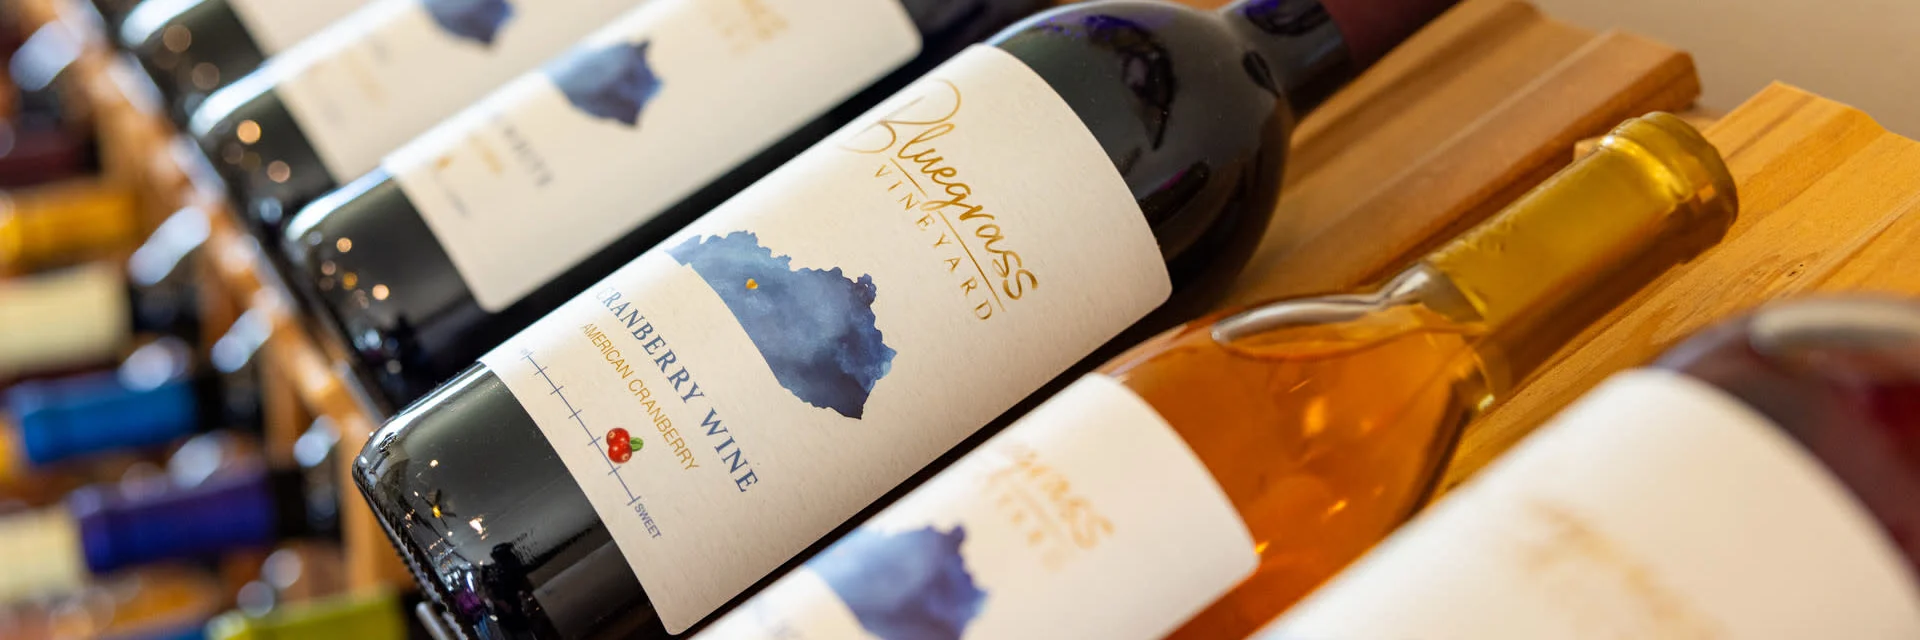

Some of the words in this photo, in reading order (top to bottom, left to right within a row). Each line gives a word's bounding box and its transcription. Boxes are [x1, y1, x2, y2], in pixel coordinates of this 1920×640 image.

[838, 78, 1038, 300] Bluegrass
[874, 163, 993, 321] VINEYARD
[579, 323, 634, 380] AMERICAN
[627, 379, 700, 471] CRANBERRY
[595, 286, 705, 404] CRANBERRY
[699, 407, 759, 493] WINE
[634, 503, 662, 539] SWEET
